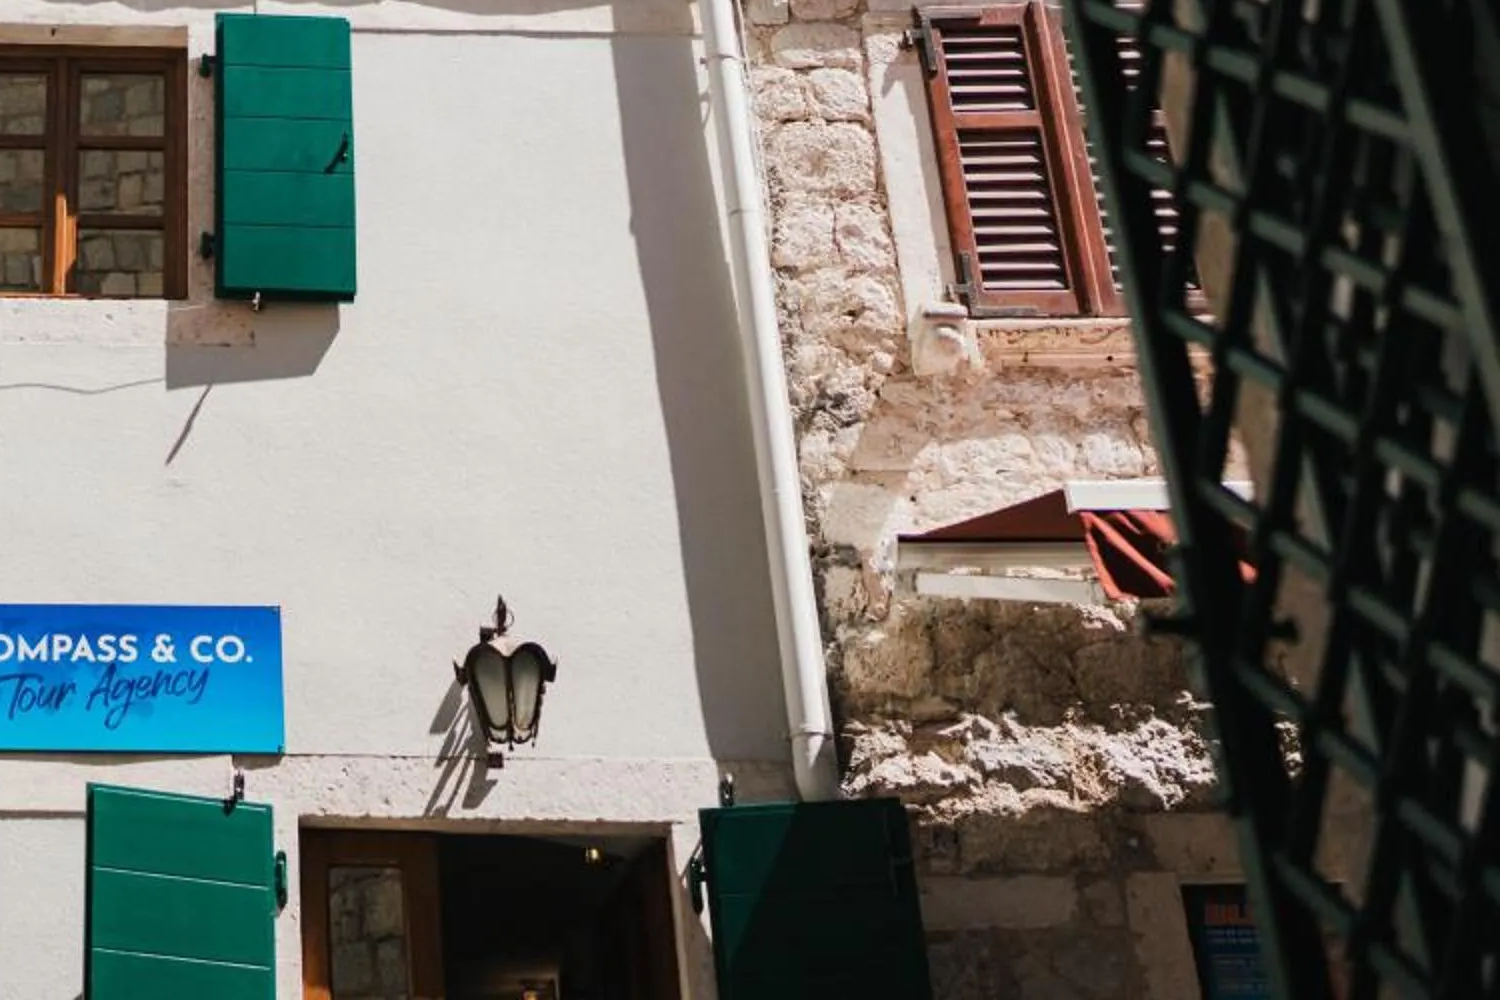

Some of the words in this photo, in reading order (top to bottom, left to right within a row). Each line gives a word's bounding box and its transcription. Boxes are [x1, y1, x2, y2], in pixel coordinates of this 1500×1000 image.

[151, 634, 177, 664] &
[190, 635, 254, 664] CO.
[85, 662, 210, 731] Agency
